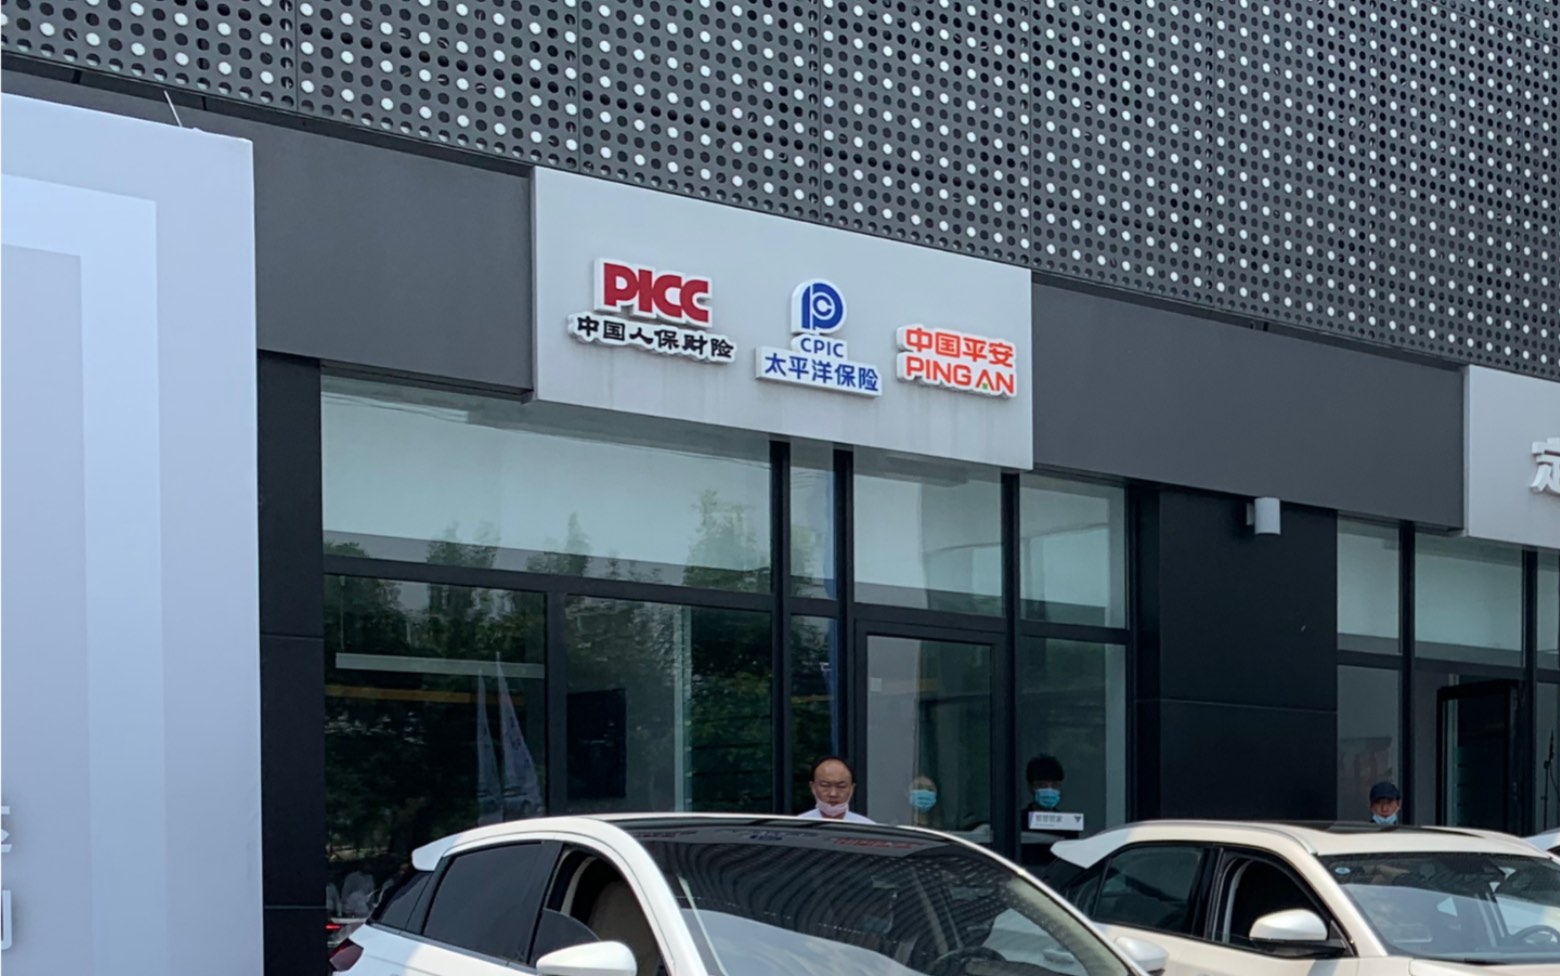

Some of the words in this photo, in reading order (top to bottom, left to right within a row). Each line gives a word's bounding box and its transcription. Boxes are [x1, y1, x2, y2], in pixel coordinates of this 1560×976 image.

[603, 262, 709, 323] PICC
[577, 315, 734, 359] 中国人保财险
[800, 337, 844, 358] CPIC
[905, 327, 1014, 369] 中国平安
[764, 352, 879, 392] 太平洋保险
